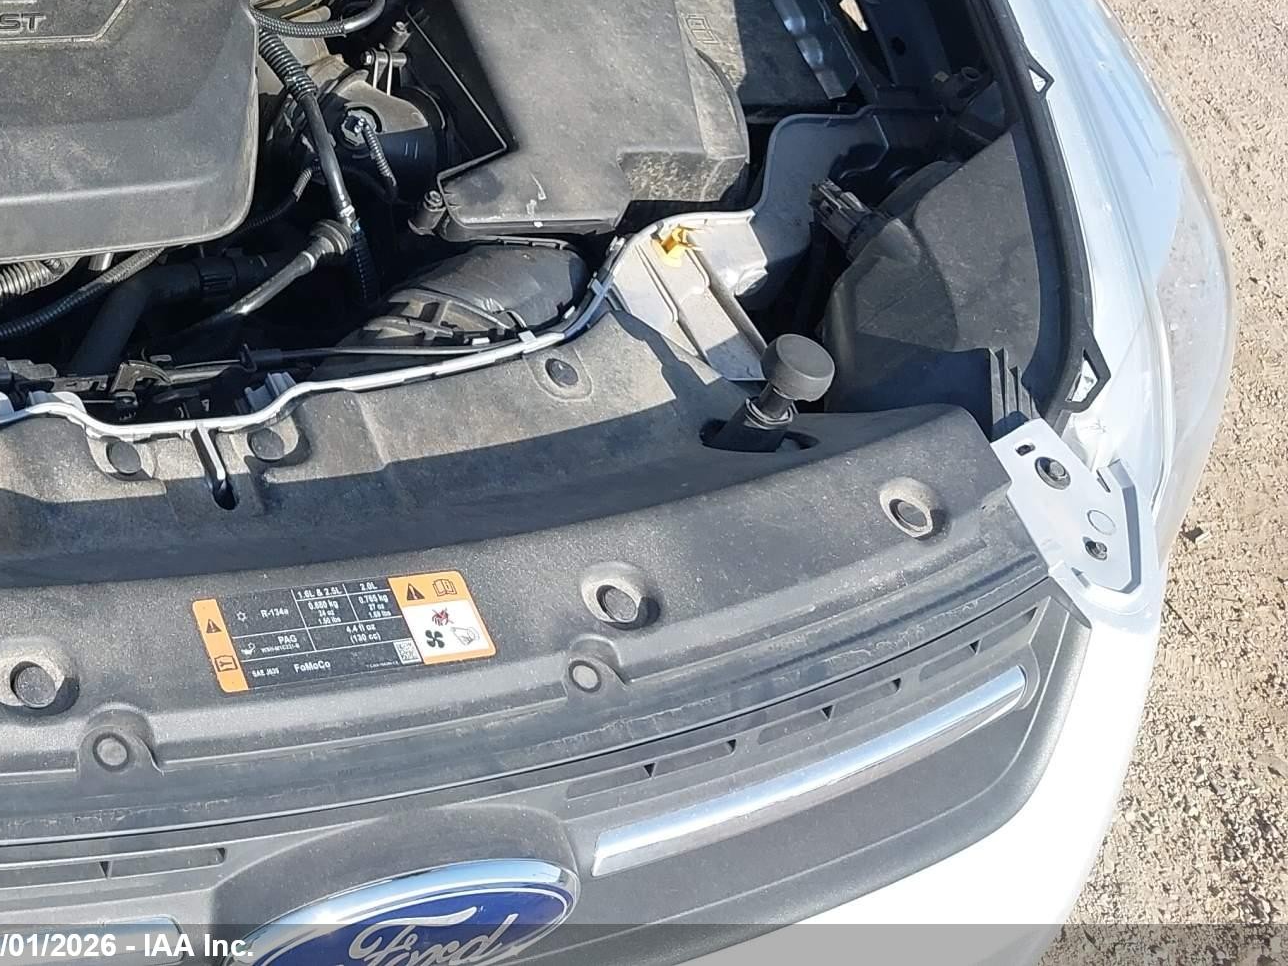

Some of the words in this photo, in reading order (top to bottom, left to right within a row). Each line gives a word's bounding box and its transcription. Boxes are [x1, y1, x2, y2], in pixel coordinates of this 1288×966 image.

[360, 581, 378, 590] 2.0L
[316, 589, 323, 597] &
[324, 586, 343, 596] 2.5L
[379, 593, 389, 603] kg
[328, 599, 339, 609] kg
[260, 609, 289, 620] R-134a
[345, 625, 360, 634] 4.4
[360, 624, 367, 633] fl
[277, 635, 298, 644] PAG
[368, 632, 382, 642] cc)
[293, 661, 331, 674] FoMoCo
